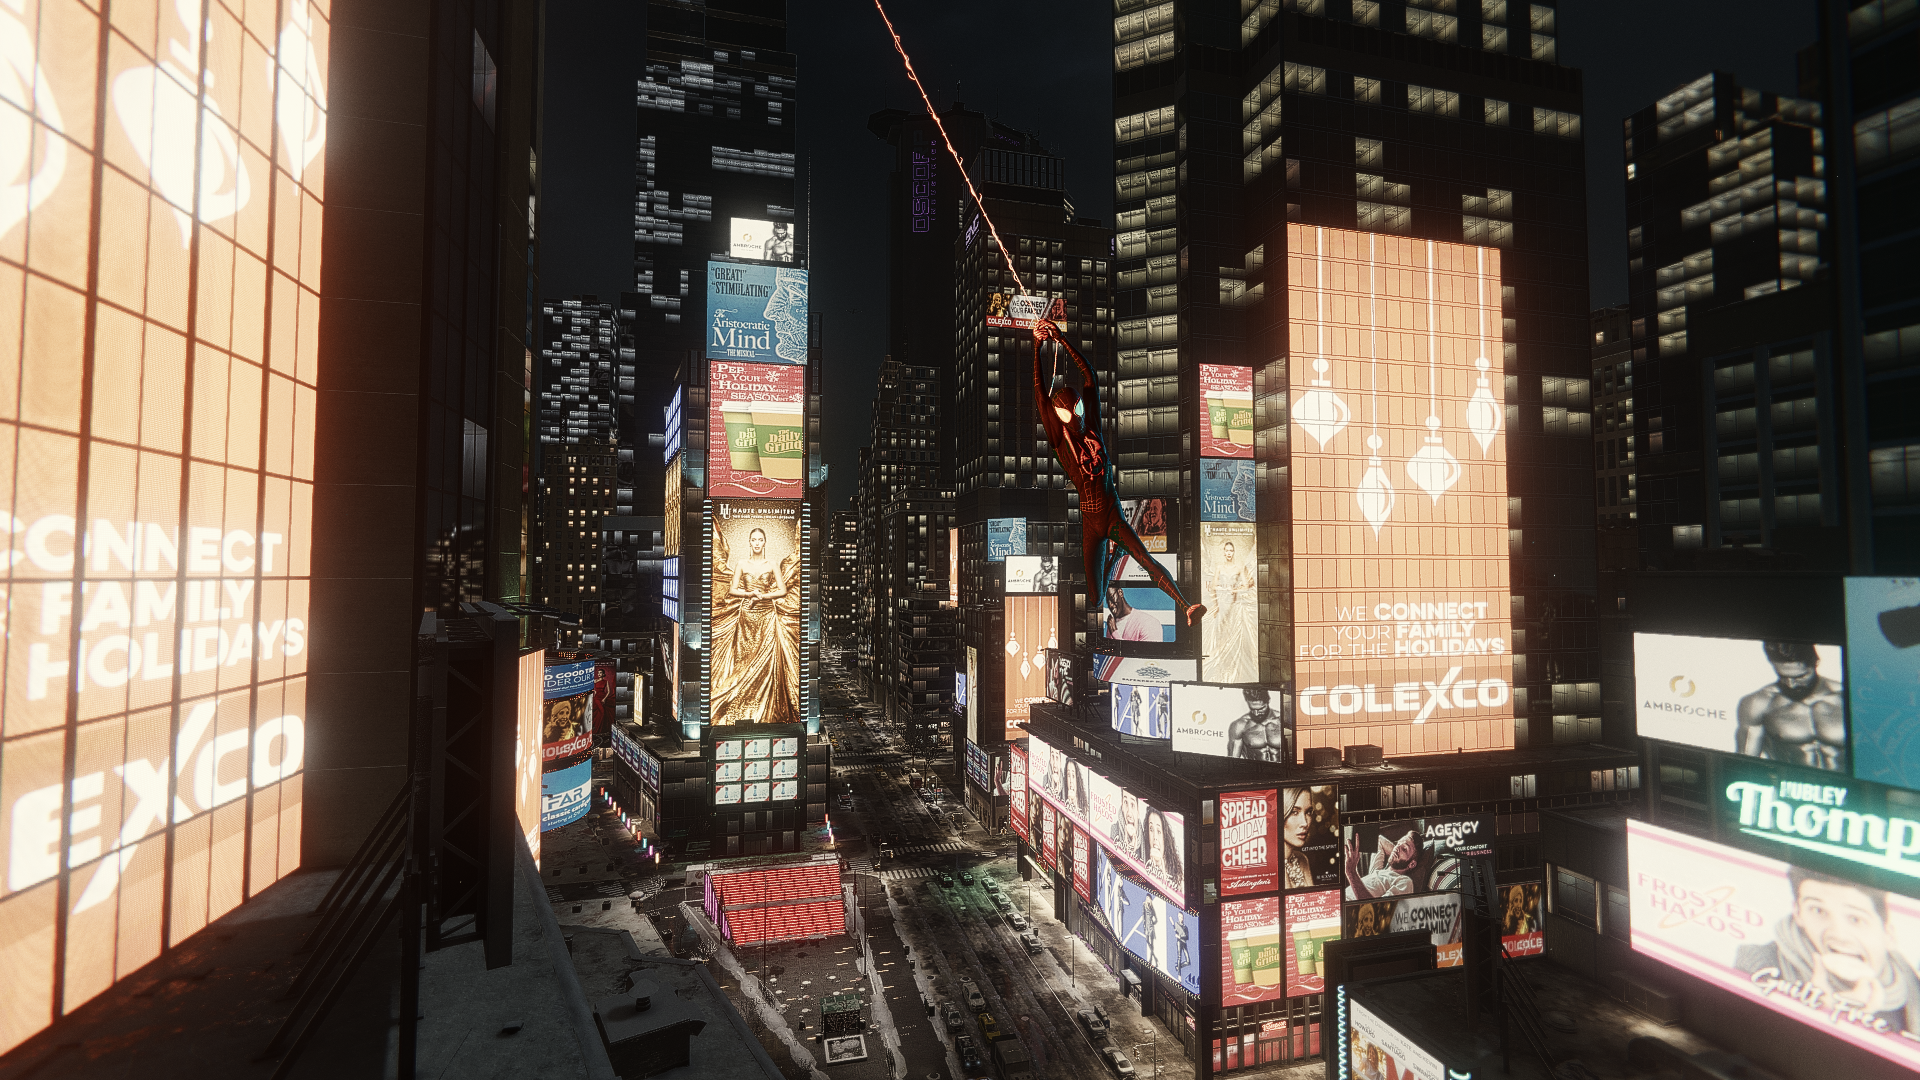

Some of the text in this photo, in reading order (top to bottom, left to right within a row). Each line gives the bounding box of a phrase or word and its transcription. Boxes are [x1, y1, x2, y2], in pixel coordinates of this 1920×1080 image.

[712, 281, 772, 298] "STIMULATING"
[712, 317, 770, 330] Aristocratic
[988, 316, 1011, 327] COLEXCO
[711, 327, 770, 350] Mind
[730, 393, 780, 401] SEASON
[1204, 500, 1236, 513] Mind
[42, 580, 254, 634] FAMILY
[1335, 602, 1488, 621] WE CONNECT
[1332, 620, 1476, 640] YOUR FAMILY
[28, 618, 305, 700] HOLIDAYS
[1299, 638, 1505, 660] FOR THE HOLIDAYS
[556, 669, 584, 679] GOOD
[1300, 666, 1509, 724] COLEXCO
[1644, 700, 1727, 720] AMBROCHE
[1176, 728, 1224, 738] AMBROCHE
[1221, 800, 1267, 828] SPREAD
[1223, 818, 1265, 847] HOLIDAY
[1425, 820, 1479, 838] AGENCY
[1222, 837, 1267, 867] CHEER
[1638, 872, 1763, 927] FROSTED
[1297, 914, 1326, 922] SEASON
[1395, 904, 1457, 925] WE CONNECT
[1650, 894, 1745, 940] HALOS
[1233, 921, 1264, 930] SEASON
[1751, 967, 1890, 1032] Guilt Free
[1354, 1020, 1375, 1038] HOWARD
[1381, 1039, 1406, 1061] SANTIAGO
